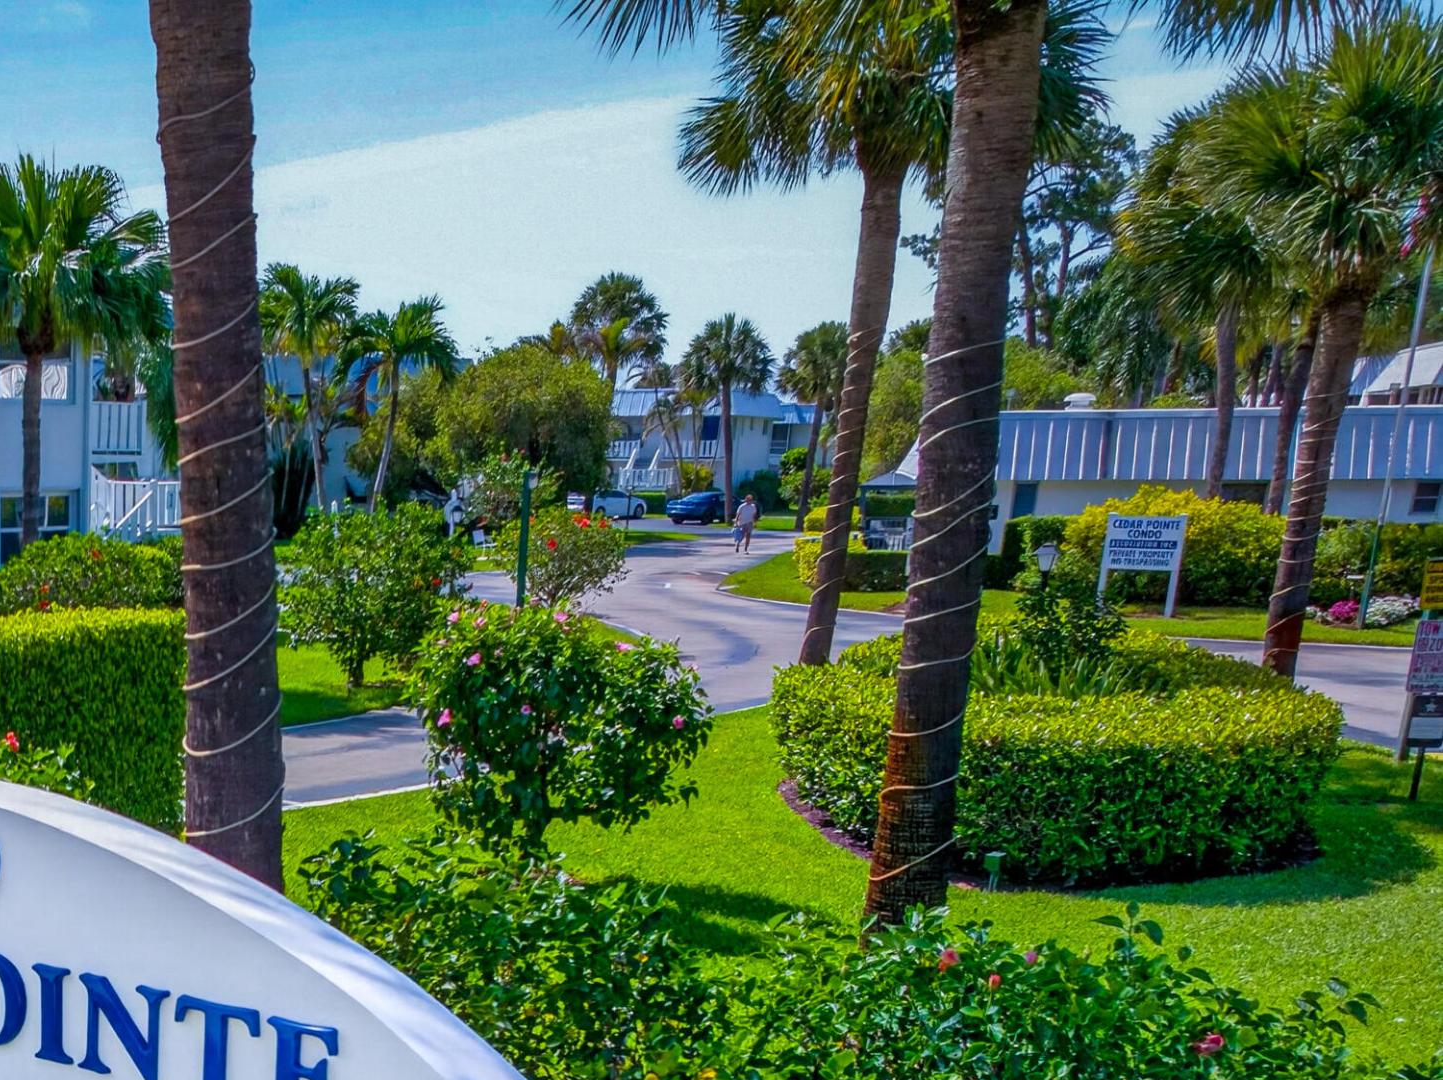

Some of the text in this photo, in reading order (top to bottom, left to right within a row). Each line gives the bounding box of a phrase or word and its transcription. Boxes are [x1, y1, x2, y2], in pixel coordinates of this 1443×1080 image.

[1113, 519, 1181, 530] CEDAR POINTE
[1127, 529, 1162, 539] CONDO
[1138, 551, 1174, 559] PROPERTY
